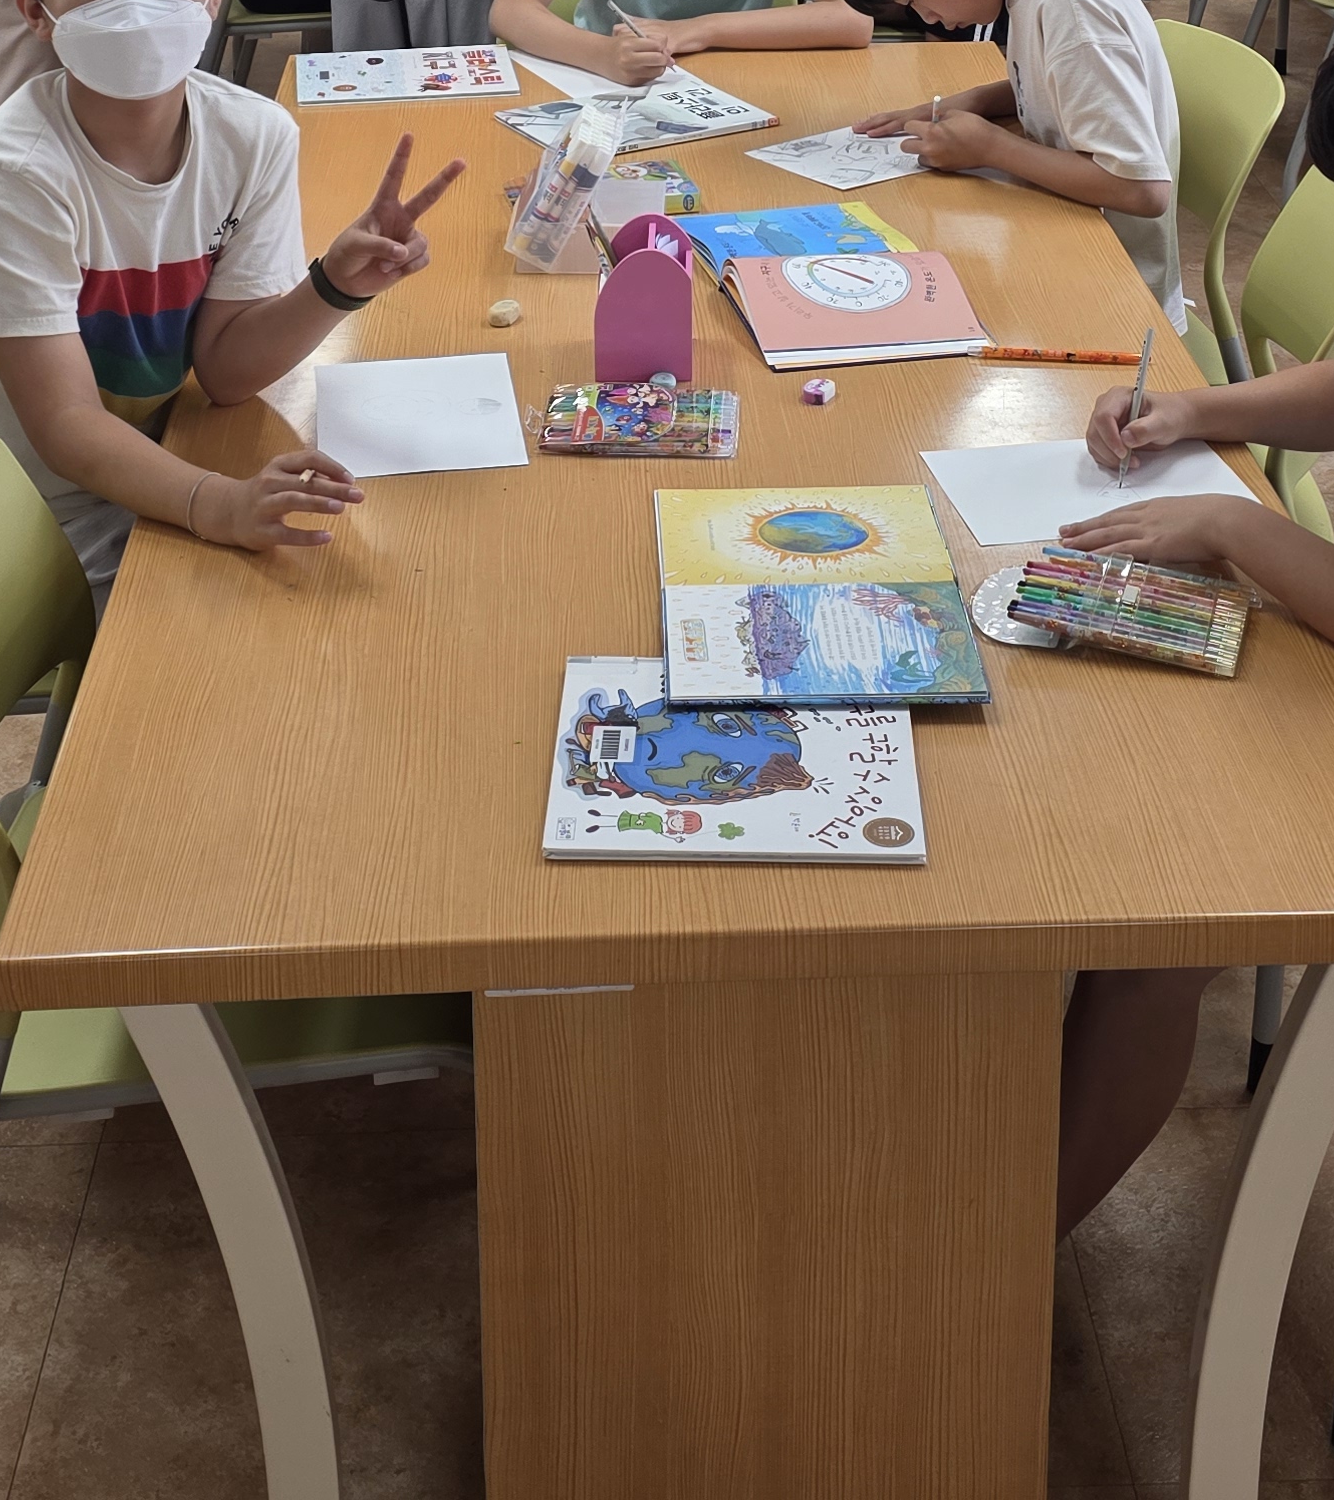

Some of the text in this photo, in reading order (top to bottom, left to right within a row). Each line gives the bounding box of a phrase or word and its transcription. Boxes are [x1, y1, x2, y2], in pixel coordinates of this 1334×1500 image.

[826, 296, 839, 305] 20
[855, 300, 863, 308] 0
[808, 704, 899, 849] 구를 구할 수 있어요!
